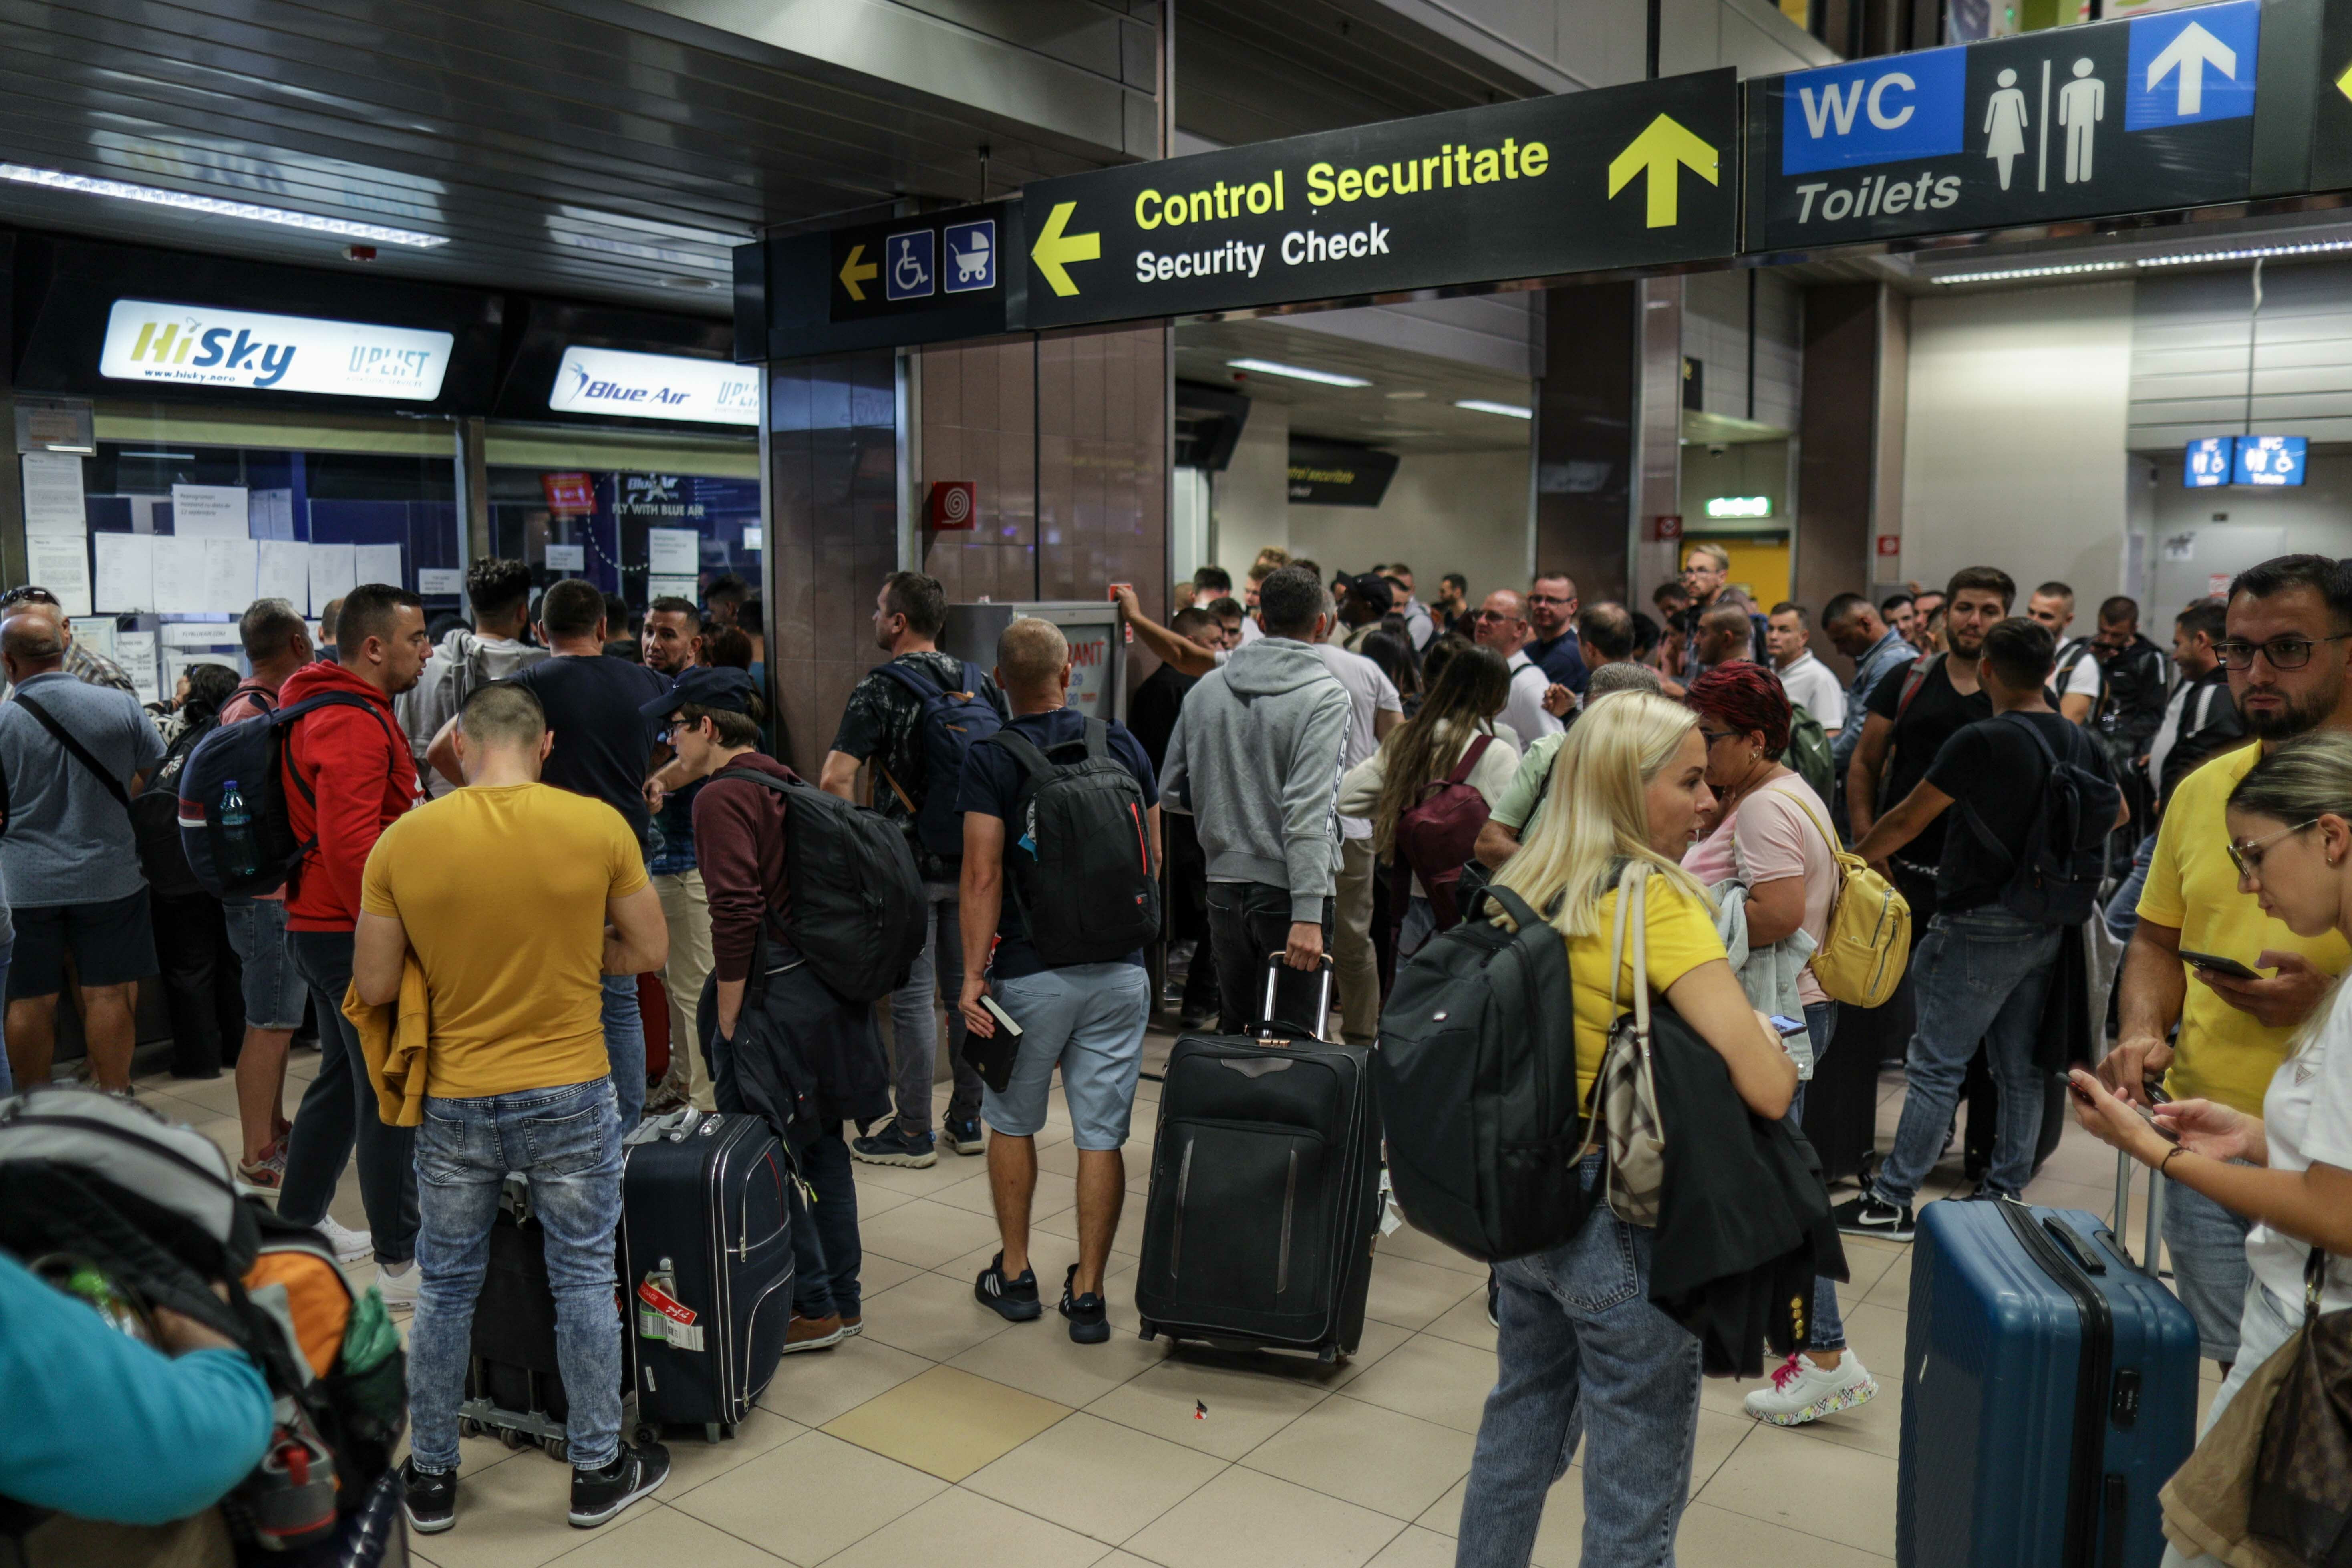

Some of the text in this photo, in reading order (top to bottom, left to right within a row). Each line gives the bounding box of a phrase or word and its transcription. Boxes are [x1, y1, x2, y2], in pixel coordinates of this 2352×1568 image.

[1799, 72, 1916, 139] WC
[1134, 137, 1549, 231] Control Securitate
[1796, 171, 1961, 224] Toilets
[1136, 222, 1390, 283] Security Check
[130, 318, 297, 386] HiSky
[584, 381, 691, 405] Blue Air
[612, 503, 705, 516] FLY WITH BLUE AIR
